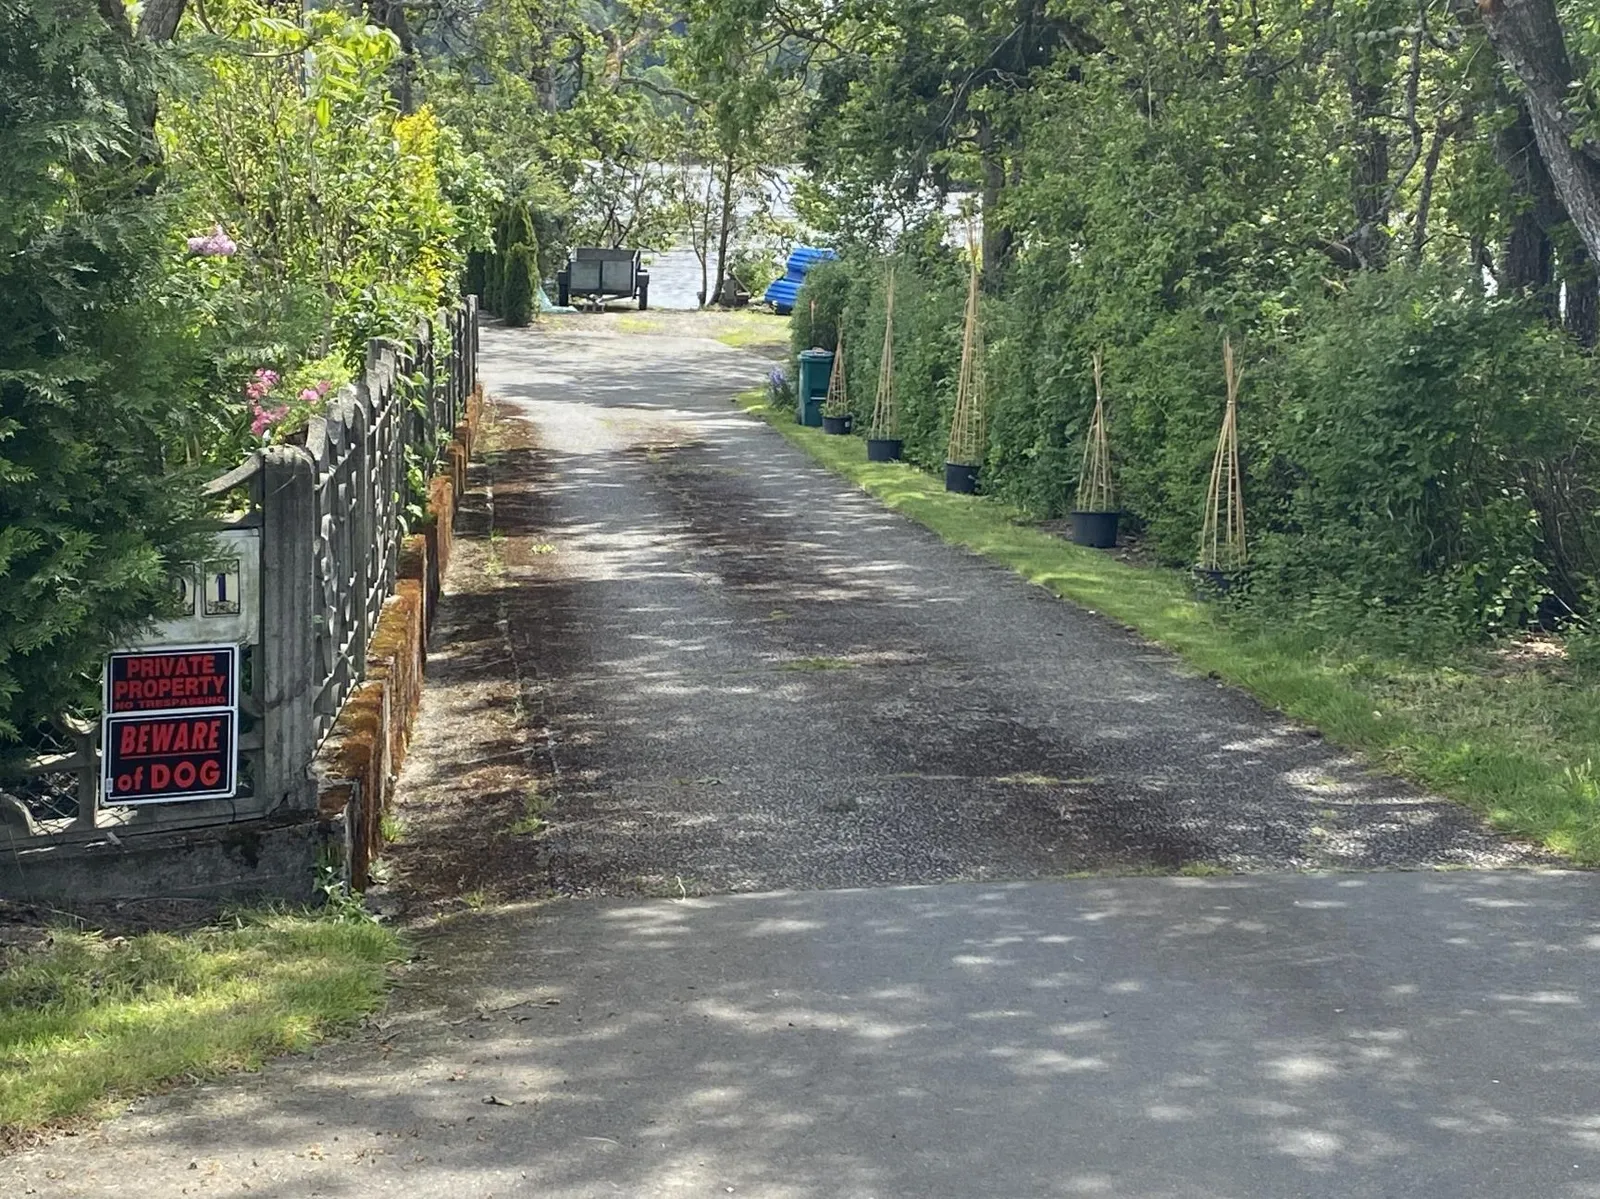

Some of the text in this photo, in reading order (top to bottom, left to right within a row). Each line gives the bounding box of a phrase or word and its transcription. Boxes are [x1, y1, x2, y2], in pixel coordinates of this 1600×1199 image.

[127, 655, 216, 678] PRIVATE
[115, 676, 226, 699] PROPERTY
[115, 701, 133, 710] NO
[120, 720, 221, 754] BEWARE
[117, 759, 221, 791] of DOG
